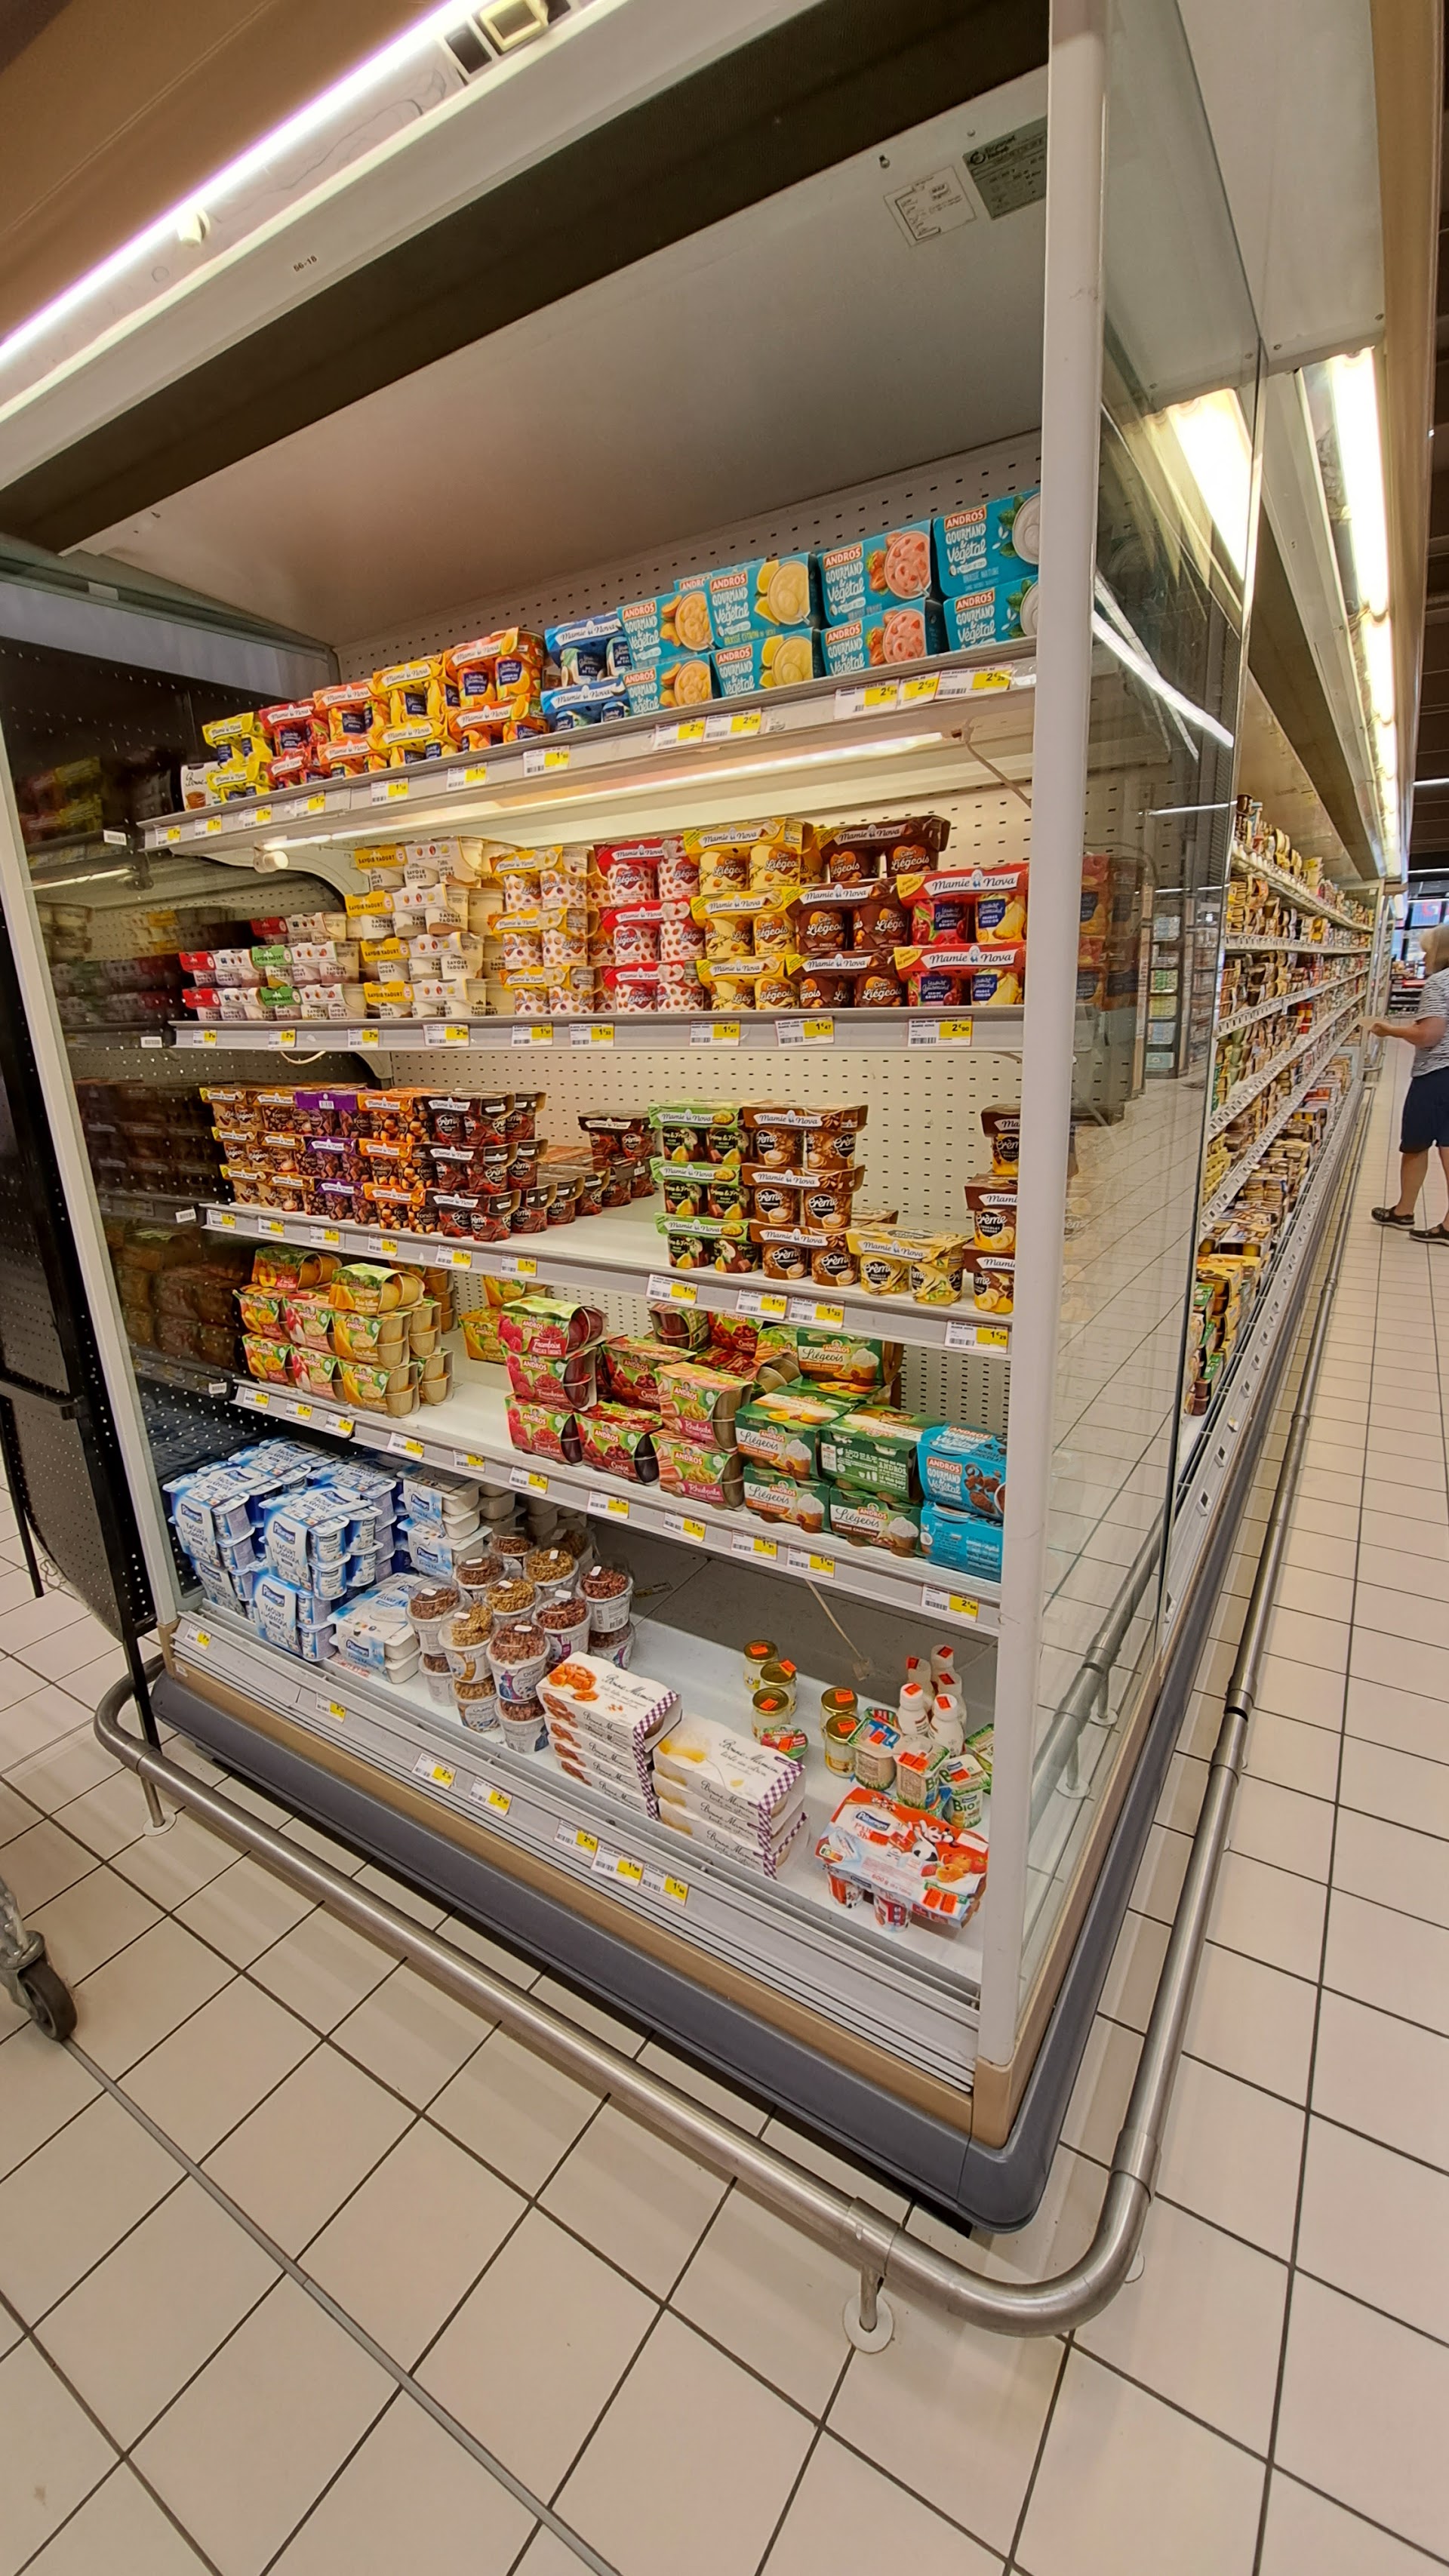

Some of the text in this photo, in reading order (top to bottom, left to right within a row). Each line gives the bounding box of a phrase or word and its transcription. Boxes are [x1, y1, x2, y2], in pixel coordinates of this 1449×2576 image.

[946, 509, 985, 528] ANDROS
[946, 523, 986, 544] GOURMAND
[825, 547, 861, 567] ANDROS
[947, 538, 987, 565] Végétal
[826, 562, 863, 583] GOURMAND
[712, 574, 746, 592] ANDROS
[827, 577, 865, 603] Végétal
[712, 587, 748, 606] GOURMAND
[956, 591, 992, 610] ANDROS
[624, 604, 654, 620] ANDROS
[714, 602, 749, 626] Végétal
[956, 605, 995, 626] GOURMAND
[827, 624, 860, 643] ANDROS
[958, 620, 996, 644] Végétal
[827, 637, 863, 658] GOURMAND
[718, 648, 751, 664] ANDROS
[626, 669, 654, 685] ANDROS
[719, 660, 753, 679] GOURMAND
[629, 682, 657, 697] OURMAND
[703, 834, 728, 845] Mamie
[736, 831, 758, 840] Nova
[839, 827, 900, 842] Mamie Nova
[891, 856, 930, 870] Liégeois
[932, 879, 970, 891] Mamie
[983, 876, 1015, 888] Nova
[804, 889, 866, 900] Mamie Nova
[709, 898, 761, 909] Mamie Nova
[808, 957, 866, 968] Mamie Nova
[930, 953, 968, 965] Mamie
[980, 951, 1012, 962] Nova
[713, 965, 736, 974] Mamie
[863, 987, 902, 1001] Liégeois
[759, 1113, 818, 1125] Mamie Nova
[758, 1172, 816, 1185] Mamie Nova
[808, 1196, 838, 1208] Crème
[986, 1194, 1017, 1203] Mami
[765, 1230, 823, 1245] Mamie Nova
[863, 1240, 924, 1258] Mamie Nova
[523, 1320, 544, 1331] ANDROS
[532, 1339, 561, 1350] Framboise
[823, 1345, 851, 1353] ANDROS
[802, 1347, 844, 1362] Liégeois
[523, 1361, 547, 1372] ANDROS
[624, 1359, 649, 1371] ANDROS
[674, 1387, 698, 1401] ANDROS
[523, 1414, 546, 1426] ANDROS
[685, 1419, 712, 1434] Rhubarbe
[594, 1430, 620, 1443] ANDROS
[740, 1430, 779, 1451] Liégeois
[760, 1431, 785, 1442] ANDROS
[675, 1452, 703, 1466] ANDROS
[928, 1459, 960, 1473] ANDROS
[927, 1468, 961, 1484] GOURMAND
[689, 1482, 721, 1497] Rhubarbe
[749, 1485, 789, 1505] Liégeois
[771, 1486, 797, 1497] ANDROS
[835, 1507, 880, 1528] Liégeois
[859, 1508, 888, 1519] ANDROS
